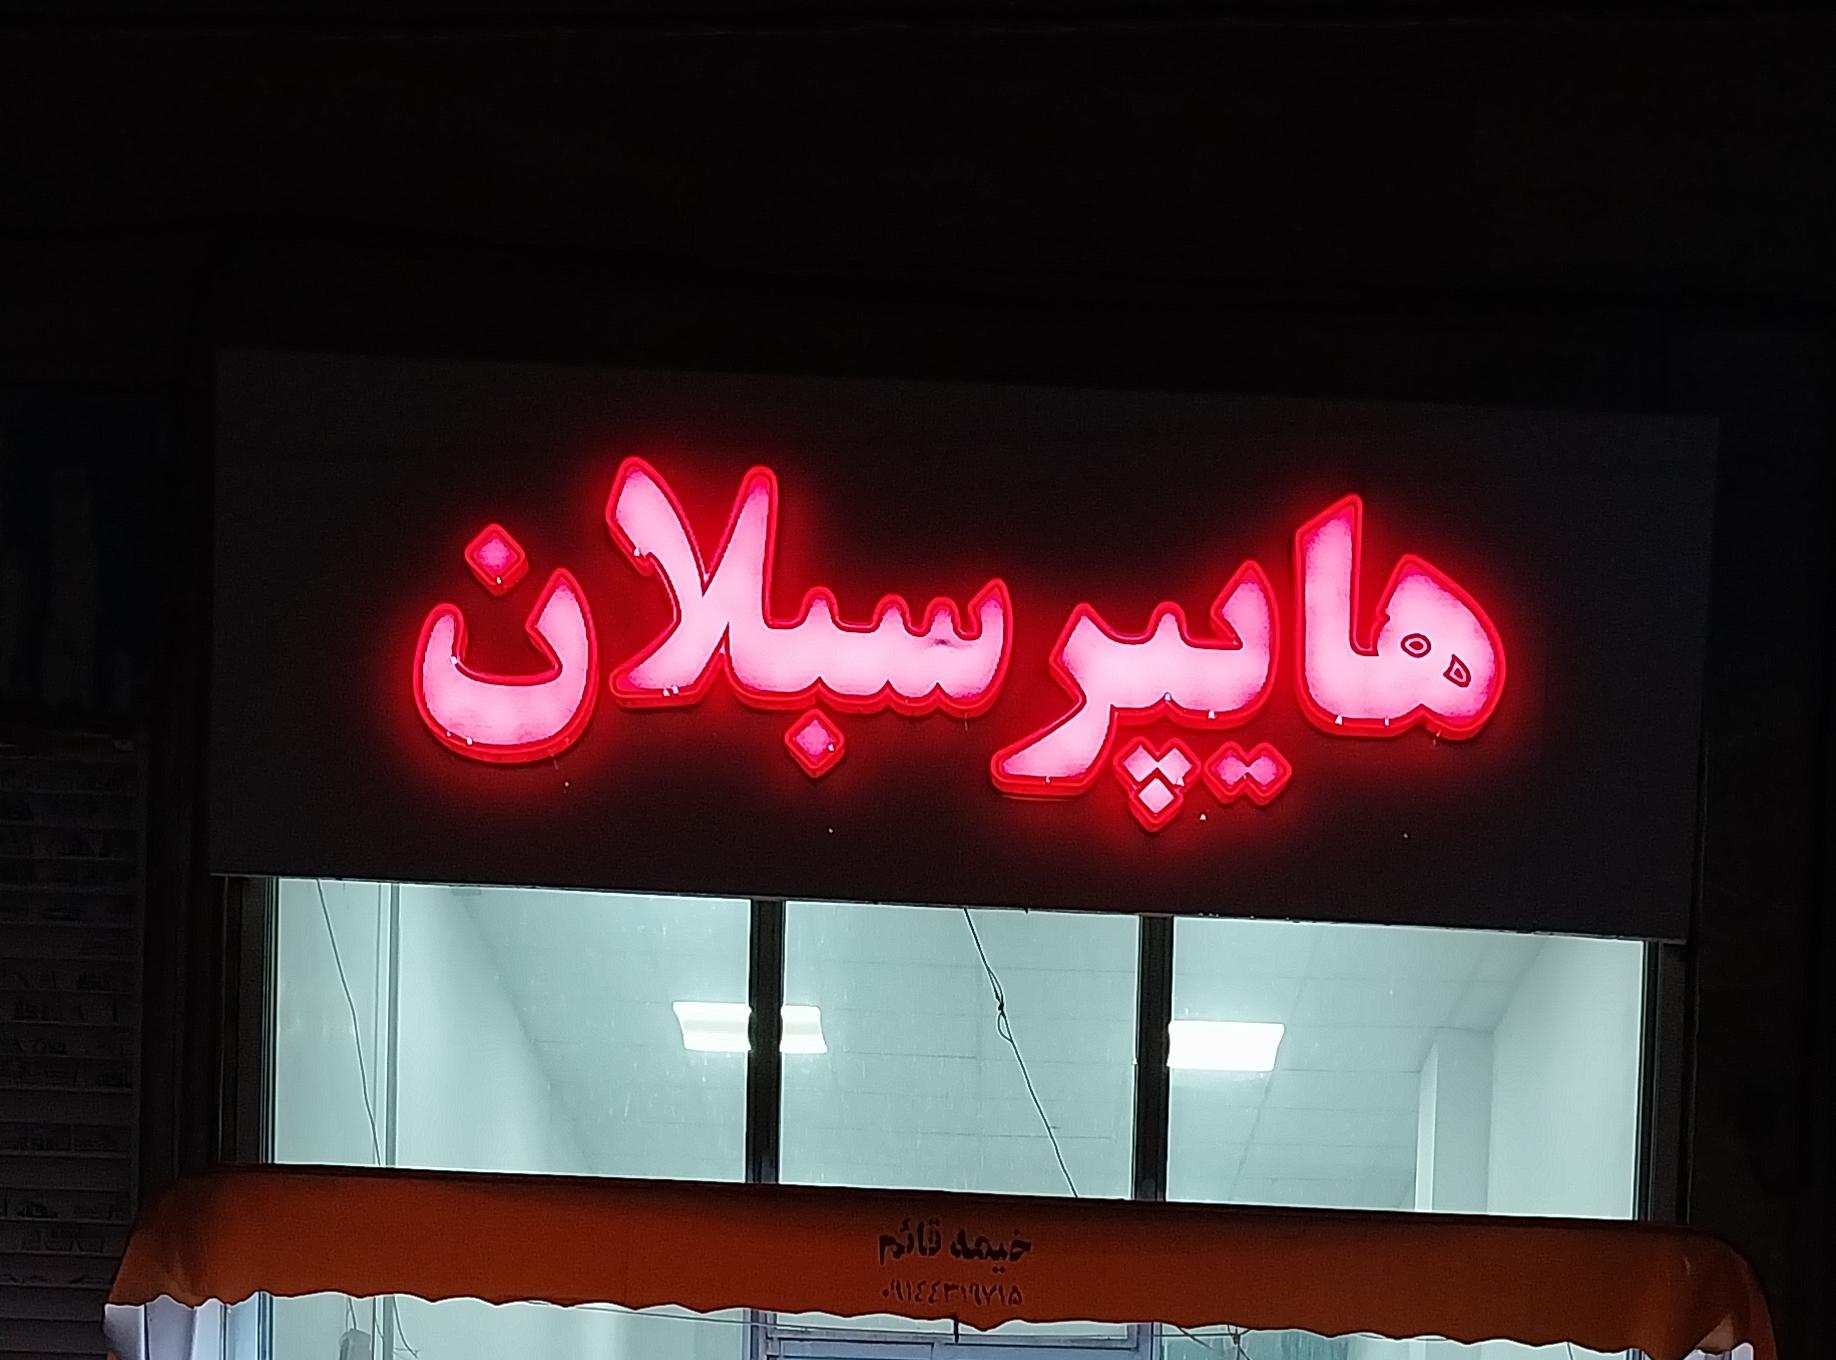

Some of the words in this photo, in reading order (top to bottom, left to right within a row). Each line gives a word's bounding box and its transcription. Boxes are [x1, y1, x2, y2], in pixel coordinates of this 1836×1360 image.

[413, 455, 1013, 776] سبلان
[993, 494, 1506, 832] هایپر
[878, 1217, 942, 1266] قائم
[950, 1228, 1032, 1274] خیمه
